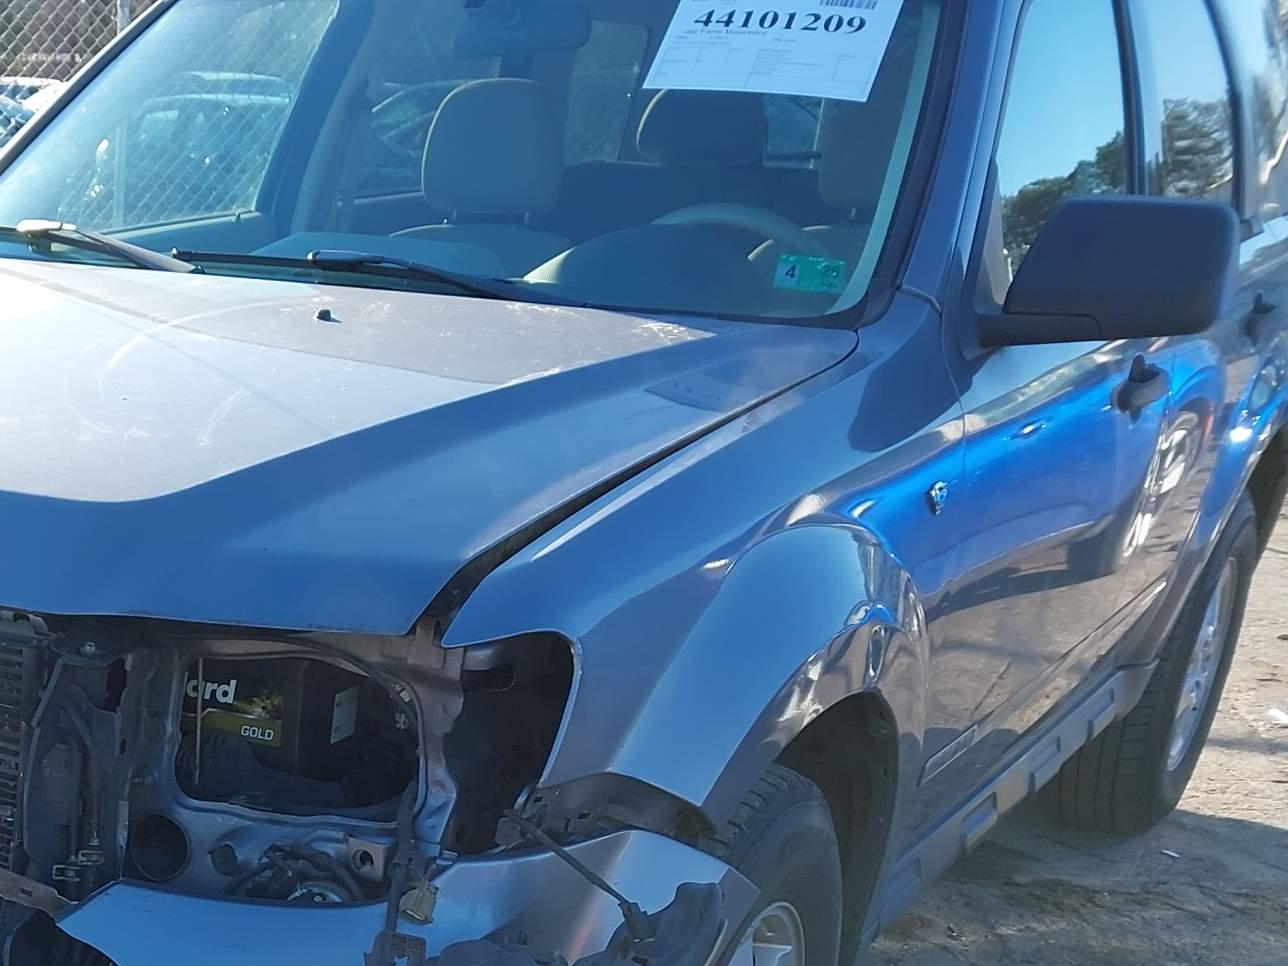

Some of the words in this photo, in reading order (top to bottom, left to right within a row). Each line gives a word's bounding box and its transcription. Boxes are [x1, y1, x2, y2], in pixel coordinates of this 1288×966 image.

[694, 9, 866, 34] 44101209
[785, 265, 796, 279] 4
[241, 725, 274, 740] GOLD
